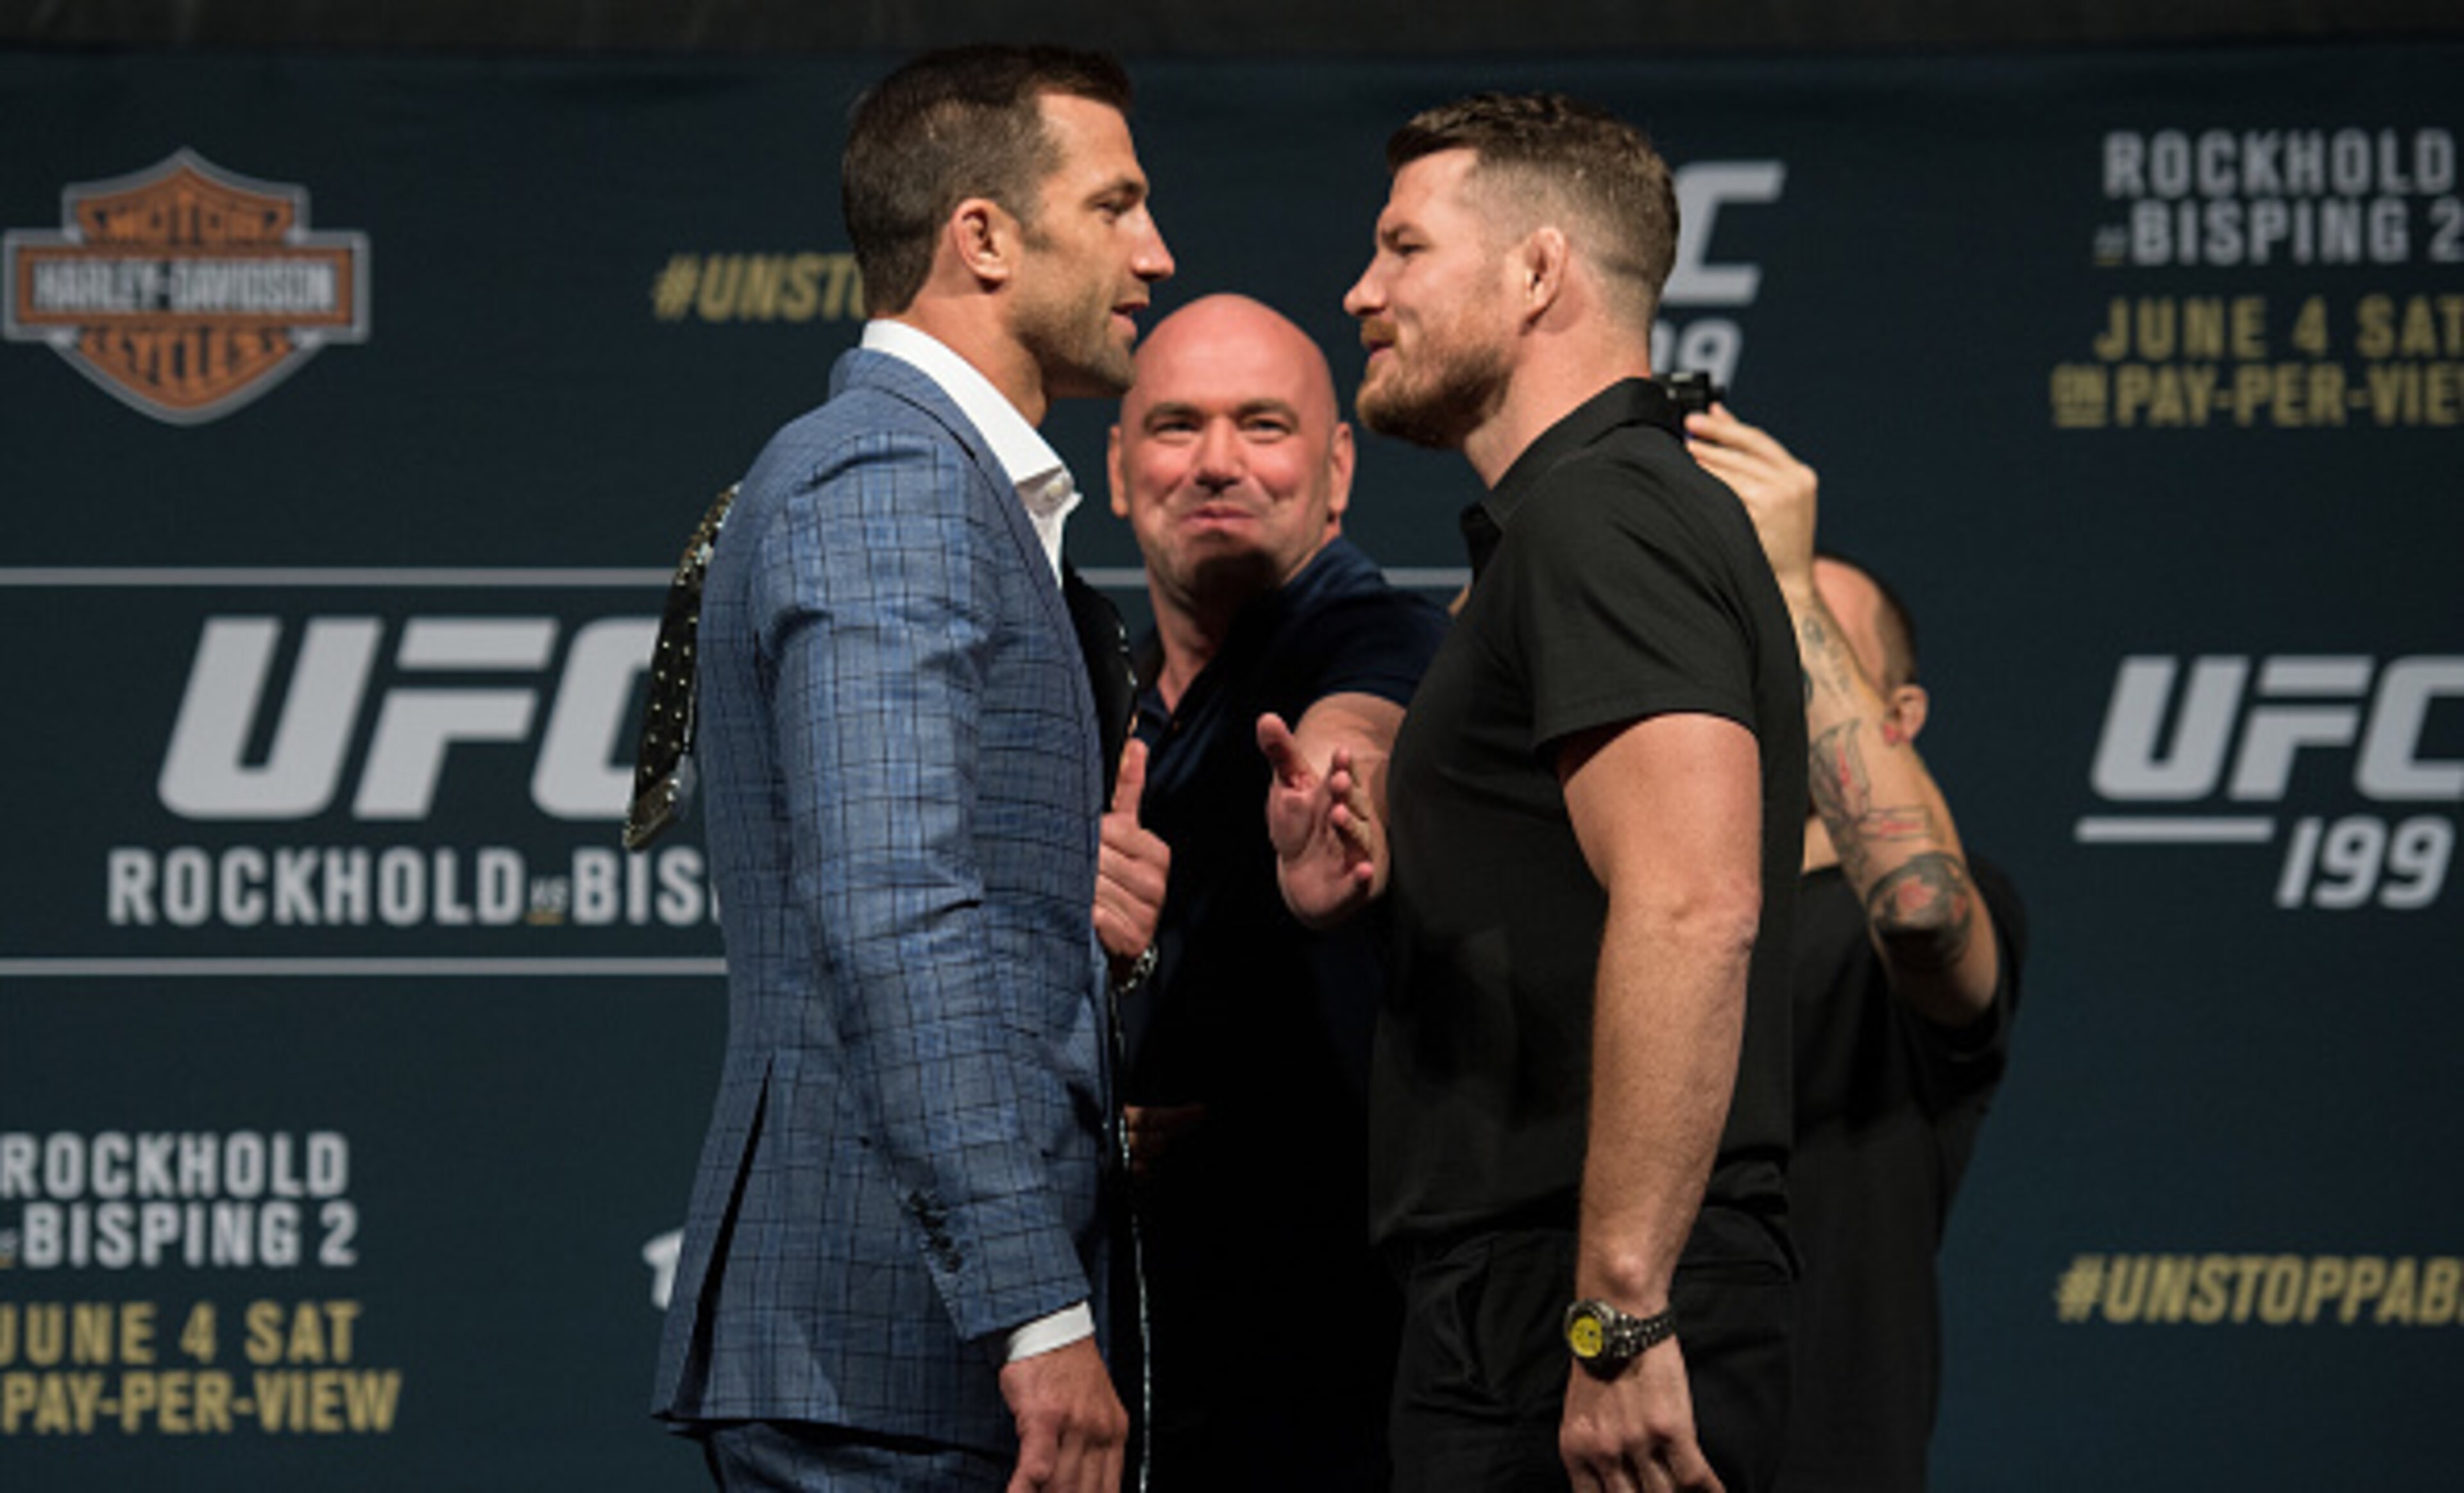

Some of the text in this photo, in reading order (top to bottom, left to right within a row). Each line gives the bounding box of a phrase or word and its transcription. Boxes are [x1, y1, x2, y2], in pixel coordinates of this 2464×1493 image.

[2103, 129, 2454, 198] ROCKHOLD
[2130, 198, 2409, 266] BISPING
[2429, 196, 2464, 262] 2
[33, 258, 336, 312] HARLEY-DAVIDSON
[2094, 296, 2464, 361] JUNE 4 SAT
[2091, 656, 2464, 801] UFC
[108, 847, 524, 925] ROCKHOLD
[572, 847, 716, 925] BIS
[2277, 817, 2454, 909] 199
[0, 1132, 348, 1199] ROCKHOLD
[23, 1201, 300, 1268] BISPING
[319, 1202, 357, 1266] 2
[2056, 1254, 2464, 1324] #UNSTOPPAB
[181, 1303, 216, 1363] 4
[245, 1302, 359, 1363] SAT
[2, 1370, 400, 1433] PAY-PER-VIEW
